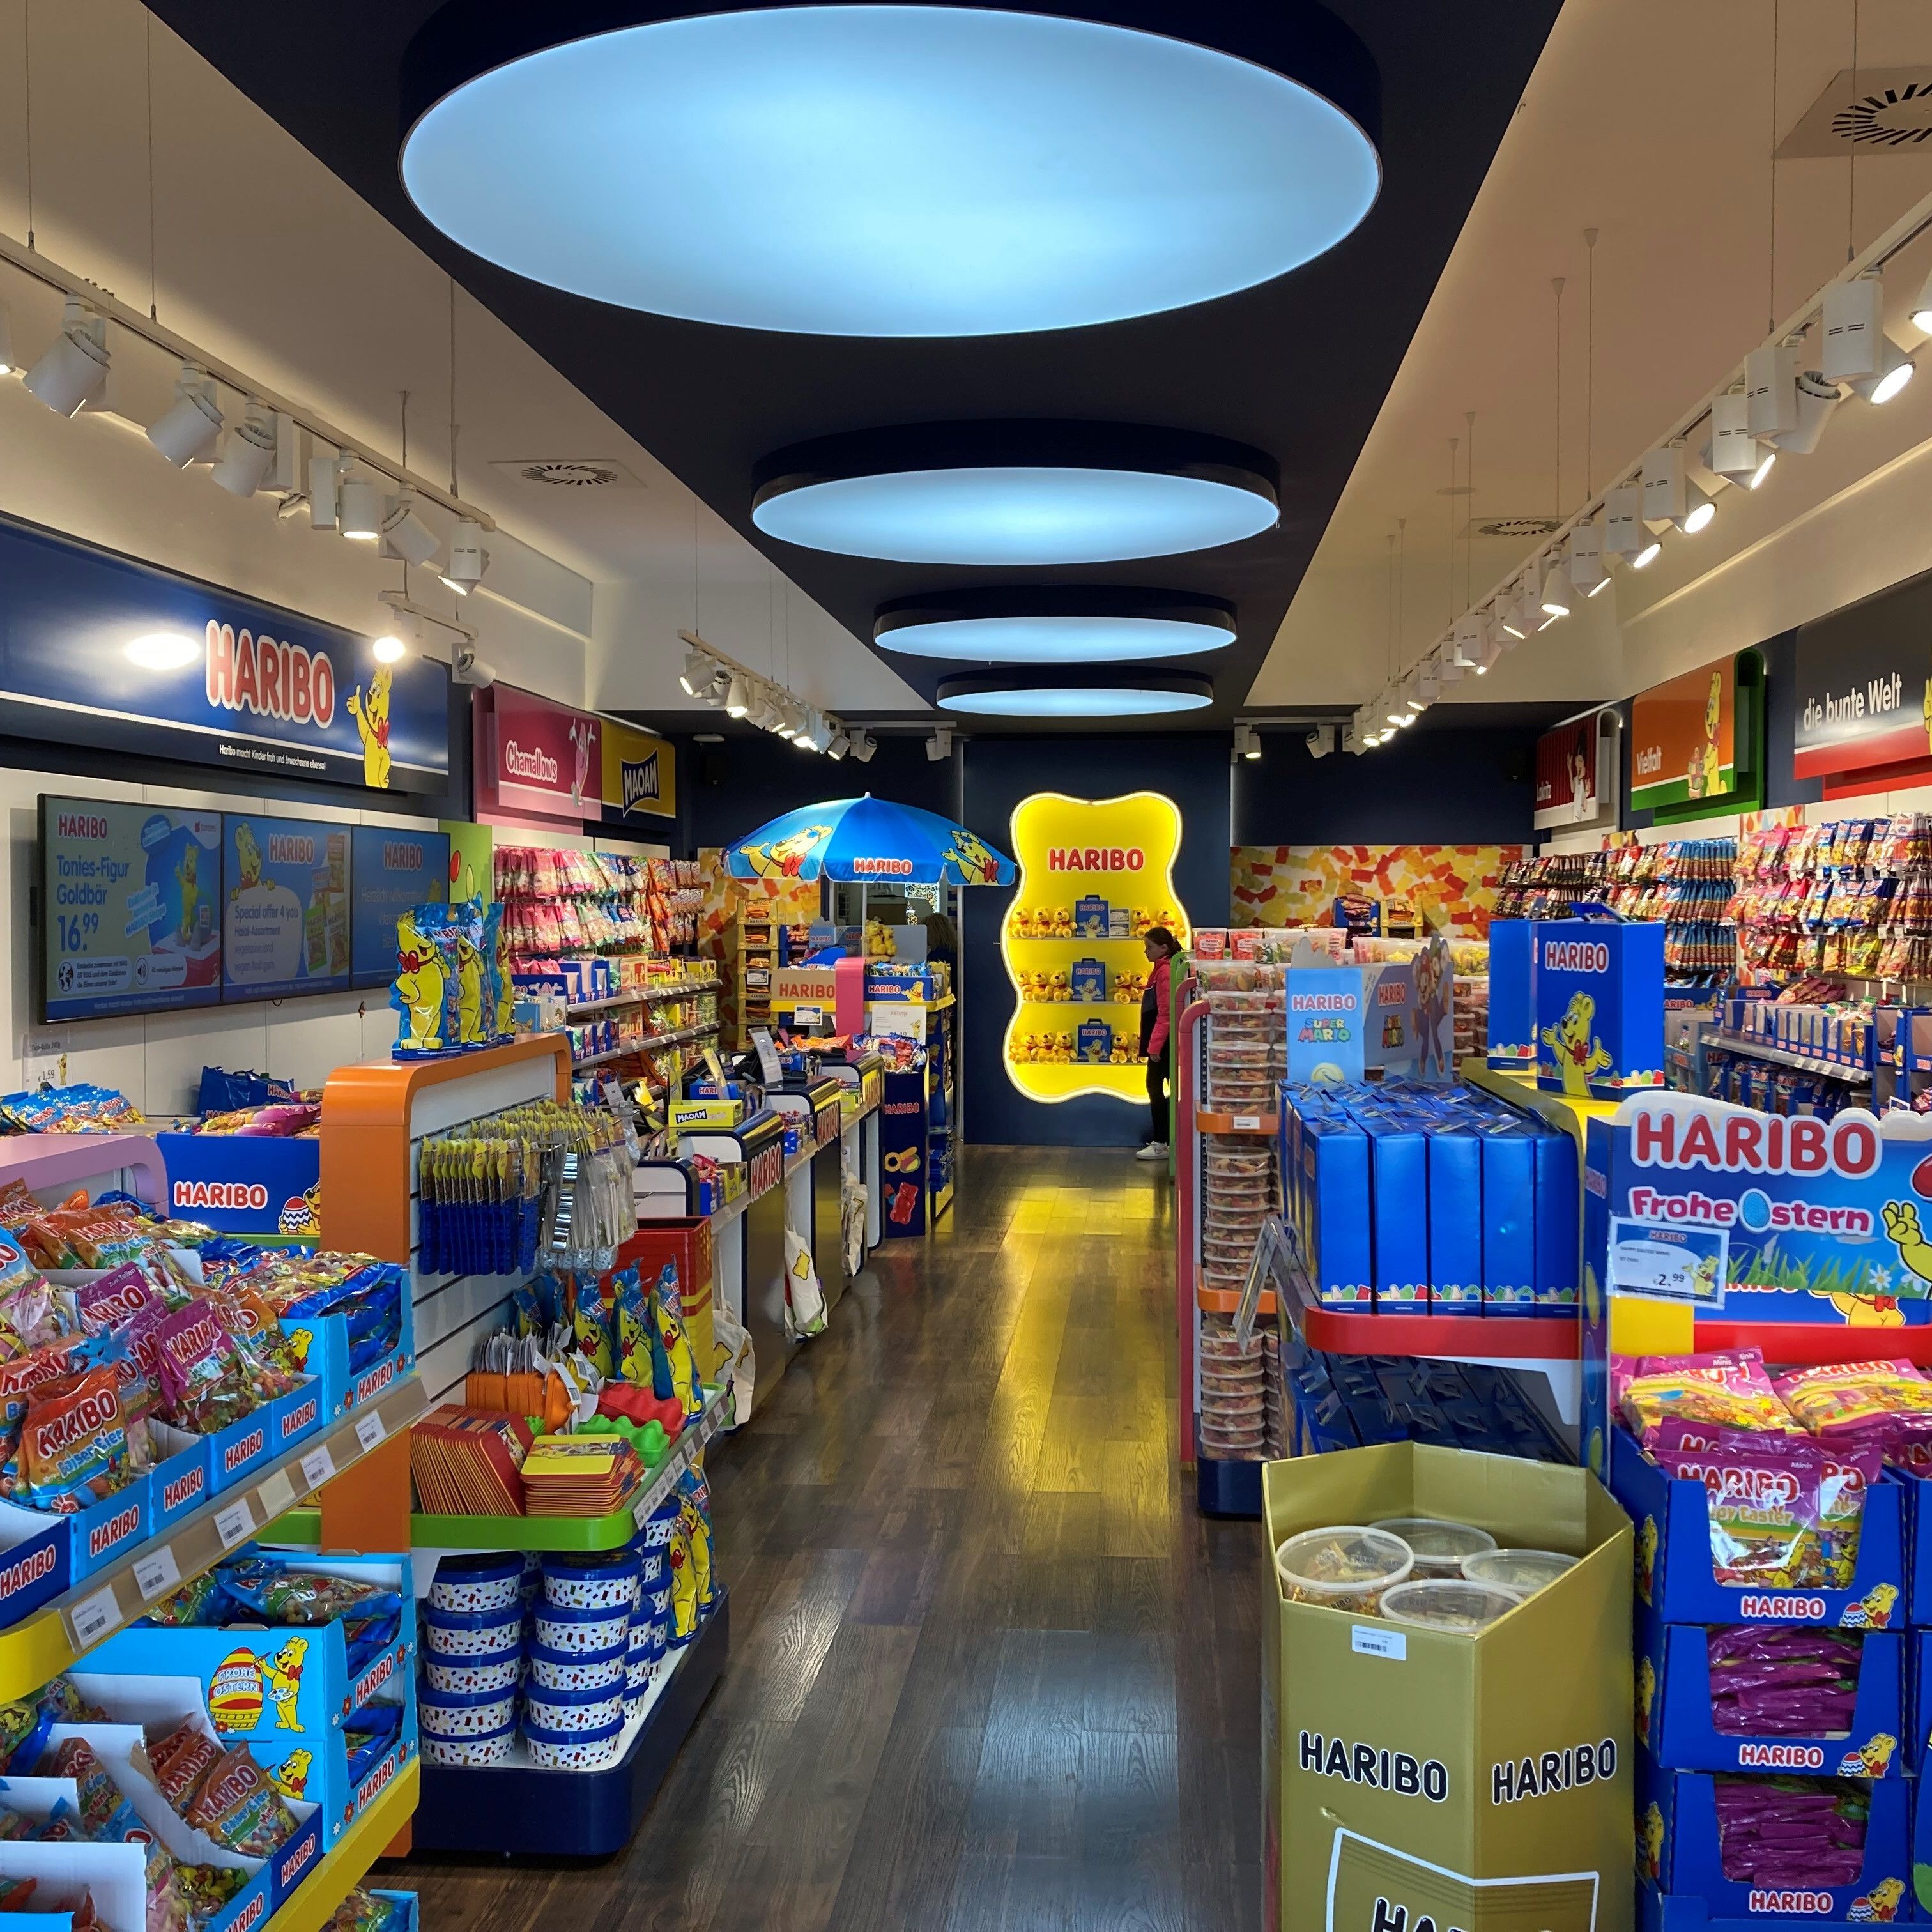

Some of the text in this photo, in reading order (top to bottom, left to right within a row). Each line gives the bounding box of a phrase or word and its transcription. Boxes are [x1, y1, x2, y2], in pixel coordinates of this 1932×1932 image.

[206, 620, 334, 728] HARIBO
[1804, 671, 1902, 731] die bunte Welt
[219, 744, 236, 756] Haribo
[252, 749, 266, 761] Kinder
[276, 754, 285, 763] und
[505, 740, 557, 783] Chamallows
[624, 760, 657, 806] MAOAM
[58, 813, 107, 839] HARIBO
[269, 833, 314, 864] HARIBO
[384, 841, 423, 870] HARIBO
[1049, 848, 1144, 871] HARIBO
[57, 855, 129, 883] Tonies-Figur
[854, 858, 913, 875] HARIBO
[57, 883, 107, 905] Goldbär
[234, 903, 298, 923] Special offer 4 you
[1080, 903, 1105, 912] HARIBO
[1545, 941, 1609, 973] HARIBO
[1076, 967, 1101, 976] HARIBO
[779, 983, 835, 999] HARIBO
[868, 984, 900, 994] HARIBO
[1379, 983, 1406, 1006] HARIBO
[1292, 994, 1357, 1011] HARIBO
[1664, 999, 1694, 1008] ARIBO
[1081, 1029, 1107, 1037] HARIBO
[1298, 1028, 1351, 1042] MARIO
[1305, 1018, 1344, 1029] SUPER
[677, 1111, 706, 1123] MAOAM
[884, 1102, 920, 1115] HARIBO
[817, 1102, 839, 1149] HARIBO
[1634, 1110, 1879, 1177] HARIBO
[751, 1141, 781, 1203] HARIBO
[174, 1181, 268, 1209] HARIBO
[1631, 1188, 1735, 1223] Frohe
[1650, 1230, 1687, 1243] HARIBO
[108, 1278, 119, 1288] Zum
[357, 1360, 393, 1405] HARIBO
[37, 1388, 118, 1459] HARIBO
[282, 1398, 316, 1439] HARIBO
[94, 1429, 125, 1450] Eier
[225, 1428, 264, 1473] HARIBO
[1791, 1461, 1813, 1469] Minis
[164, 1466, 204, 1512] HARIBO
[1678, 1464, 1801, 1503] HARIBO
[1739, 1503, 1794, 1526] Easter
[90, 1504, 139, 1558] HARIBO
[0, 1545, 56, 1598] HARIBO
[1741, 1596, 1826, 1619] HARIBO
[218, 1666, 256, 1682] FROHE
[355, 1653, 393, 1707] HARIBO
[213, 1682, 259, 1698] OSTERN
[1300, 1730, 1448, 1802] HARIBO
[1739, 1744, 1824, 1768] HARIBO
[358, 1754, 395, 1806] HARIBO
[1492, 1738, 1617, 1805] HARIBO
[194, 1765, 259, 1823] HARIBO
[258, 1805, 276, 1825] Mini
[281, 1833, 316, 1887] HARIBO
[1749, 1889, 1833, 1913] HARIBO
